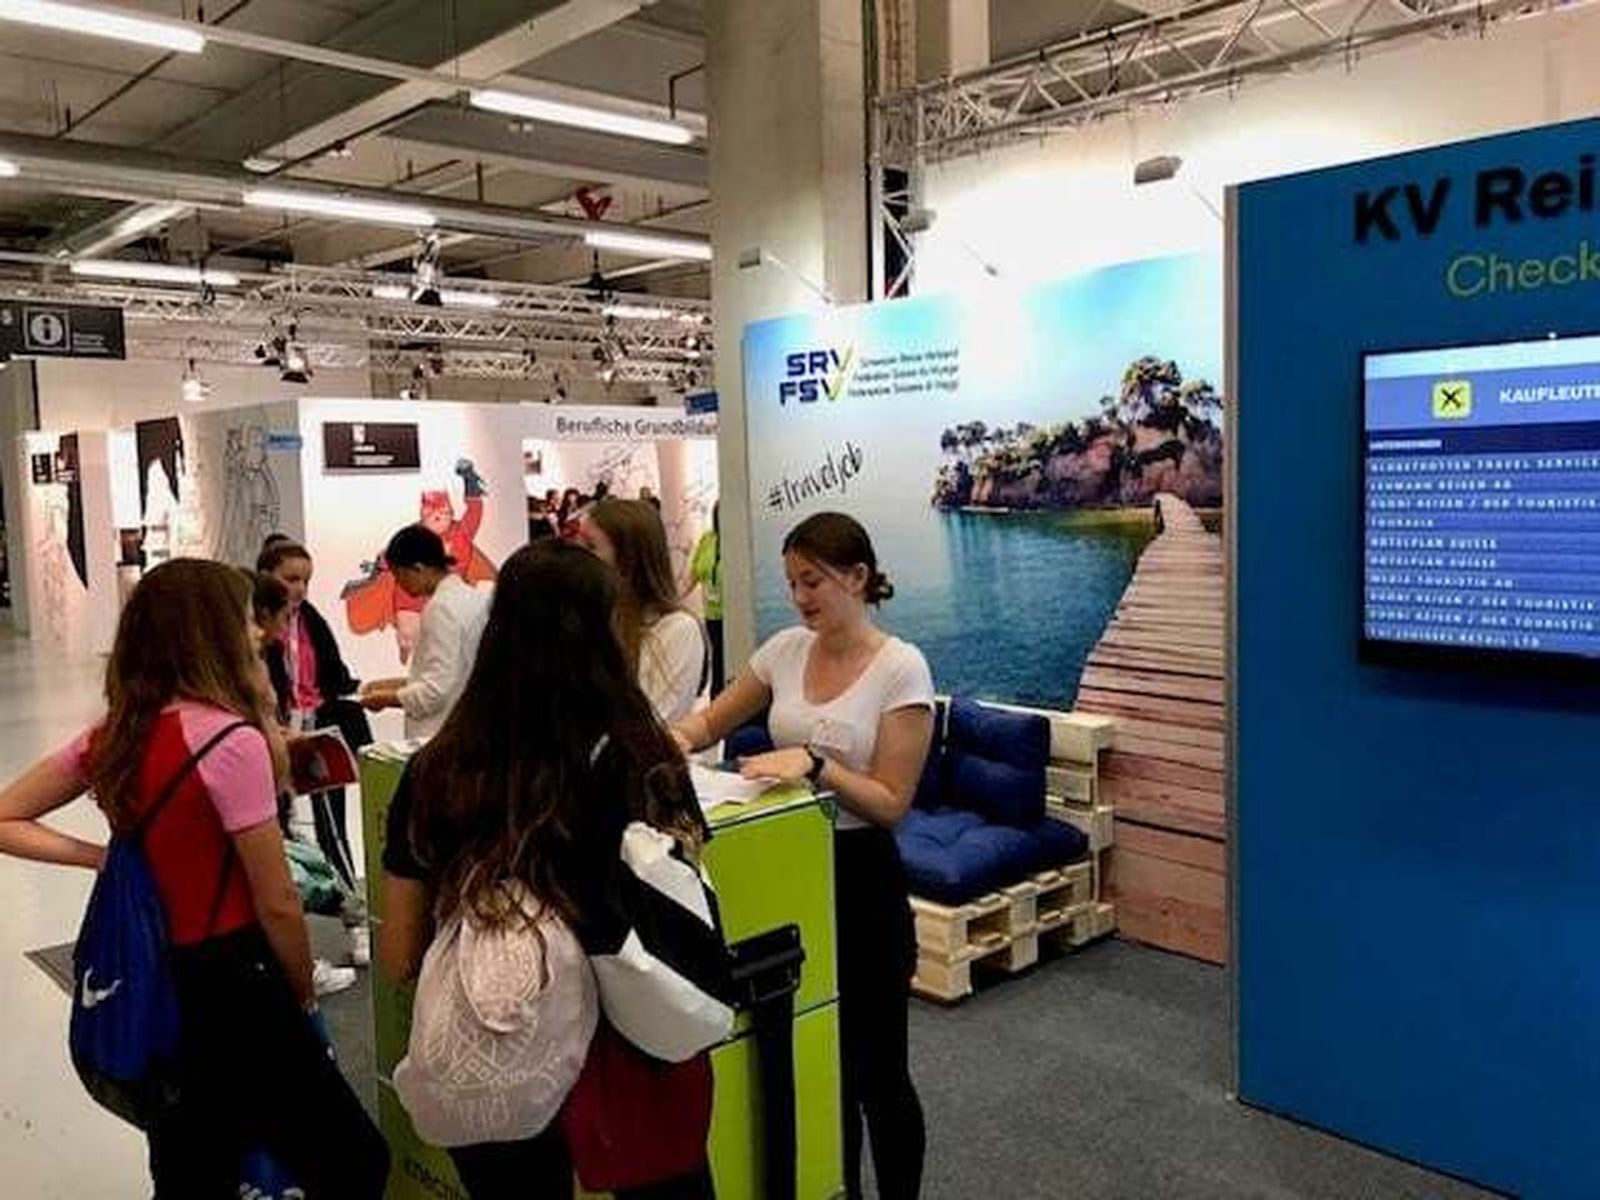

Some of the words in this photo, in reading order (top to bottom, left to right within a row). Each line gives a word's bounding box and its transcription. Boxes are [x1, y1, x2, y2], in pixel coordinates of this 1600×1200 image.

[1354, 177, 1451, 243] KV
[1475, 154, 1595, 229] Rei
[786, 344, 852, 378] SRV
[779, 376, 844, 406] FSV
[556, 416, 630, 436] Berufliche
[768, 442, 863, 510] #Traveljob
